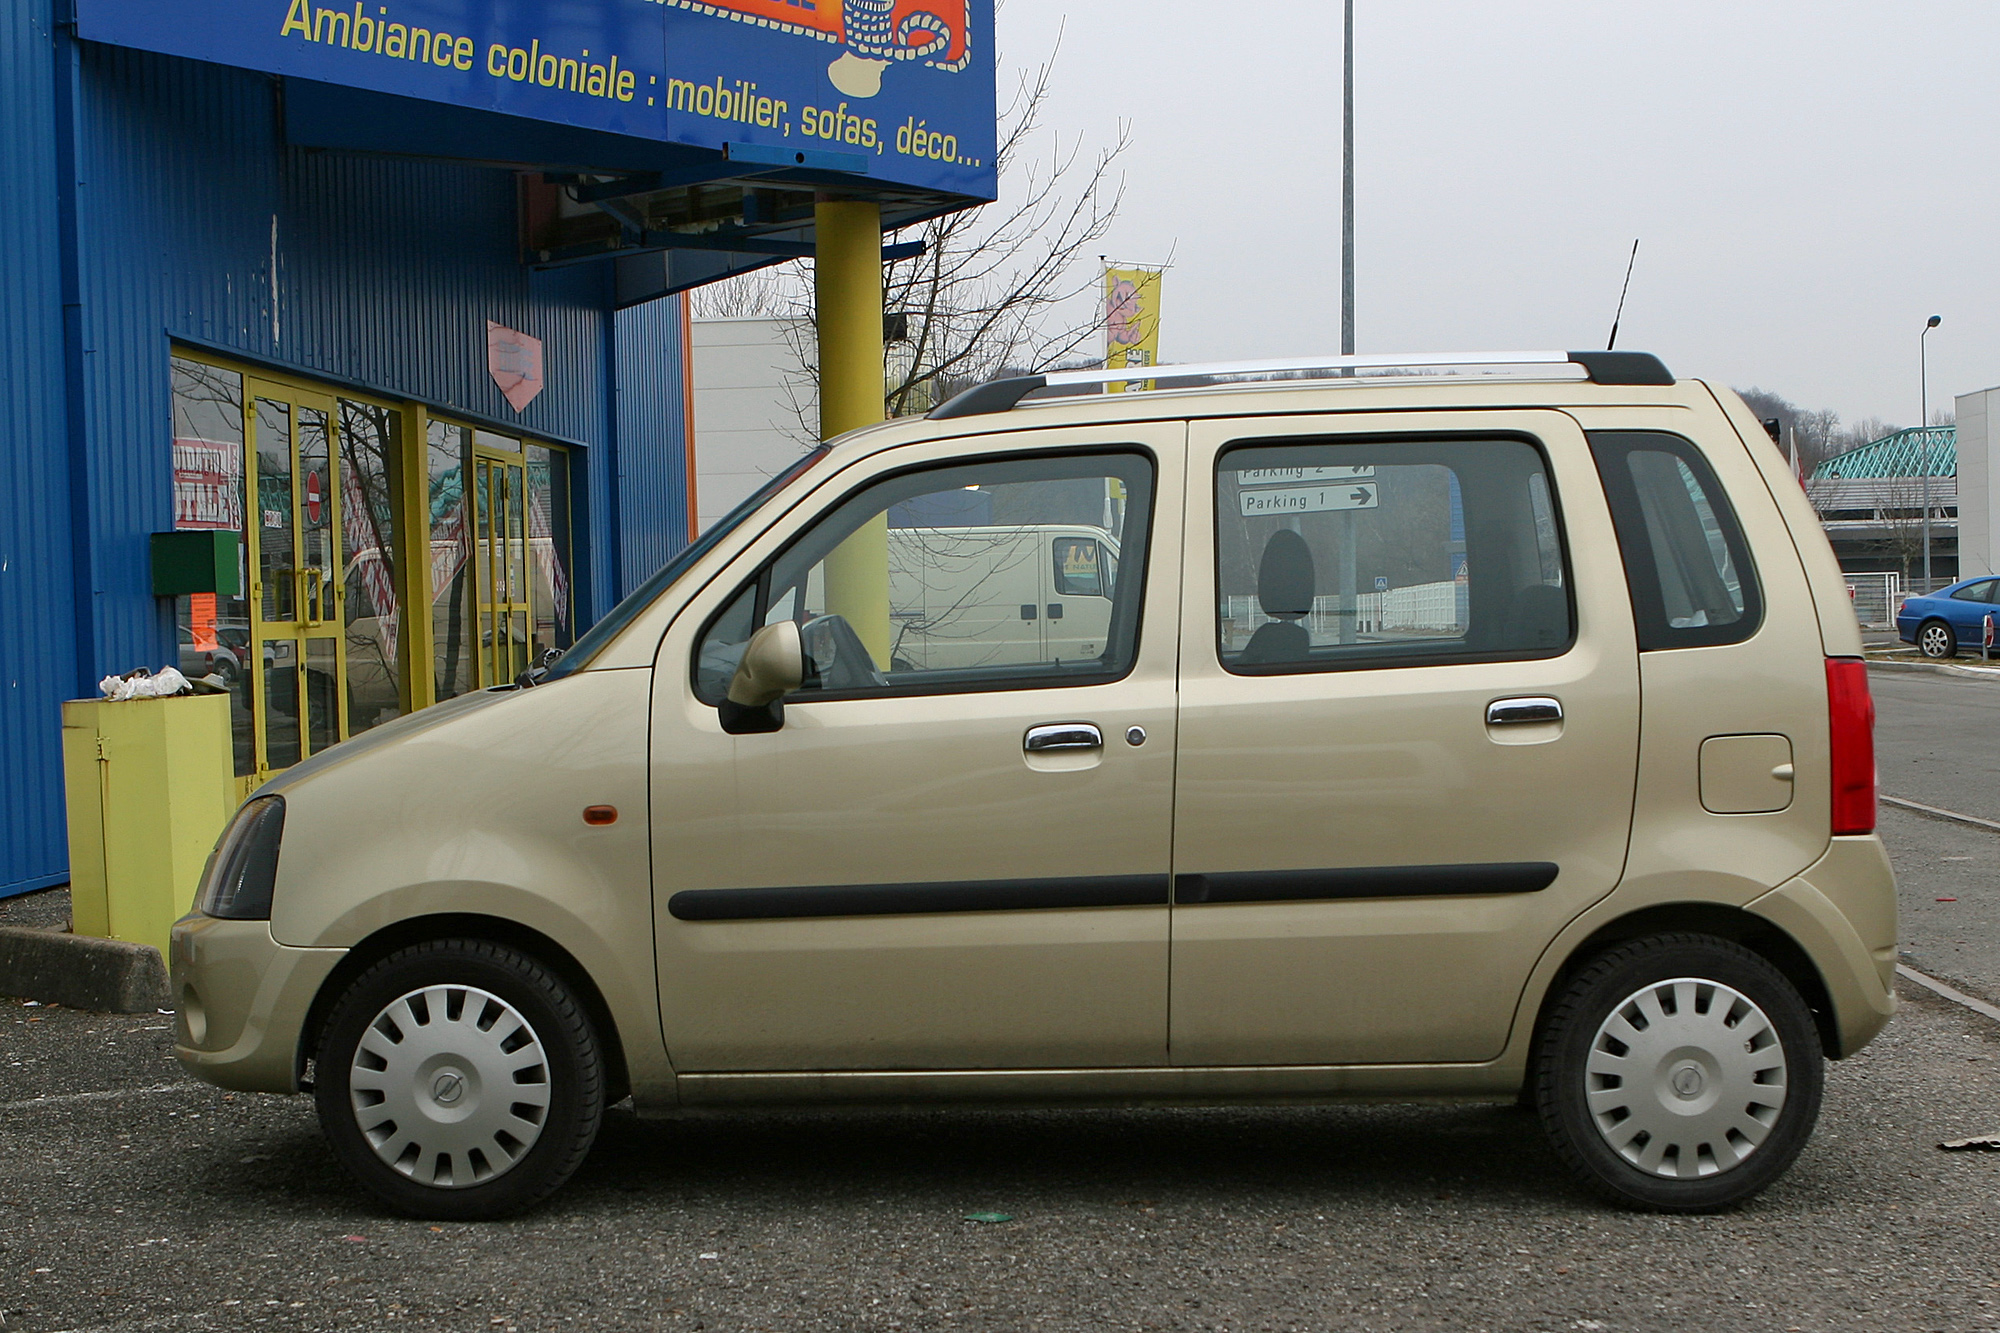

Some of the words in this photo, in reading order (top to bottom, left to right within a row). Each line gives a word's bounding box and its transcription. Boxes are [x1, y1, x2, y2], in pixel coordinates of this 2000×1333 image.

[281, 0, 473, 71] Ambiance
[487, 39, 635, 102] coloniale
[648, 76, 656, 106] :
[666, 76, 790, 137] mobilier,
[801, 102, 884, 156] sofas,
[896, 116, 981, 167] déco...
[1246, 495, 1307, 509] Parking
[1319, 492, 1324, 505] 1
